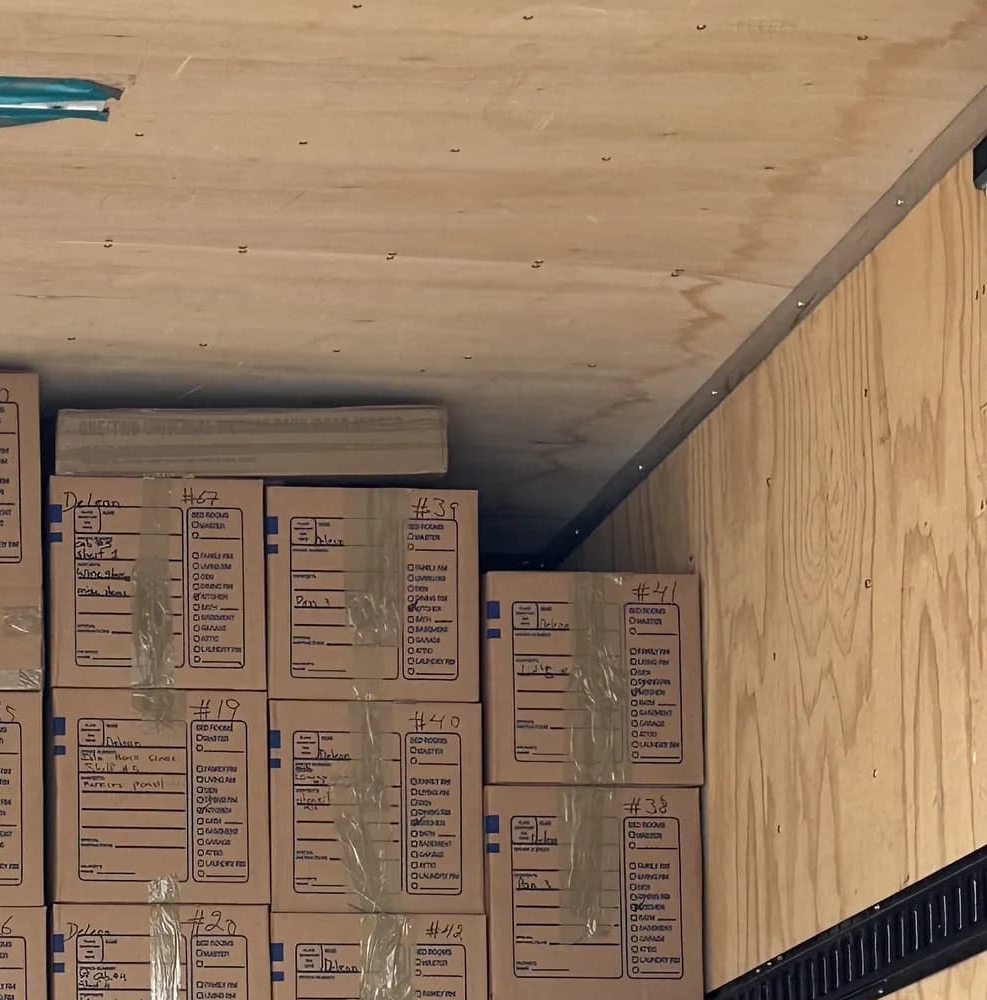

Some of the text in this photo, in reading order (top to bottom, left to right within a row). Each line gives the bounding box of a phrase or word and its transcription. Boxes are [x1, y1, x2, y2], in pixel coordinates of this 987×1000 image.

[182, 488, 220, 506] #67
[412, 497, 459, 519] #39
[632, 580, 677, 603] #41
[190, 699, 240, 730] #19
[409, 711, 461, 731] #40
[623, 796, 668, 814] #38
[181, 910, 237, 938] #20
[426, 920, 463, 941] #42
